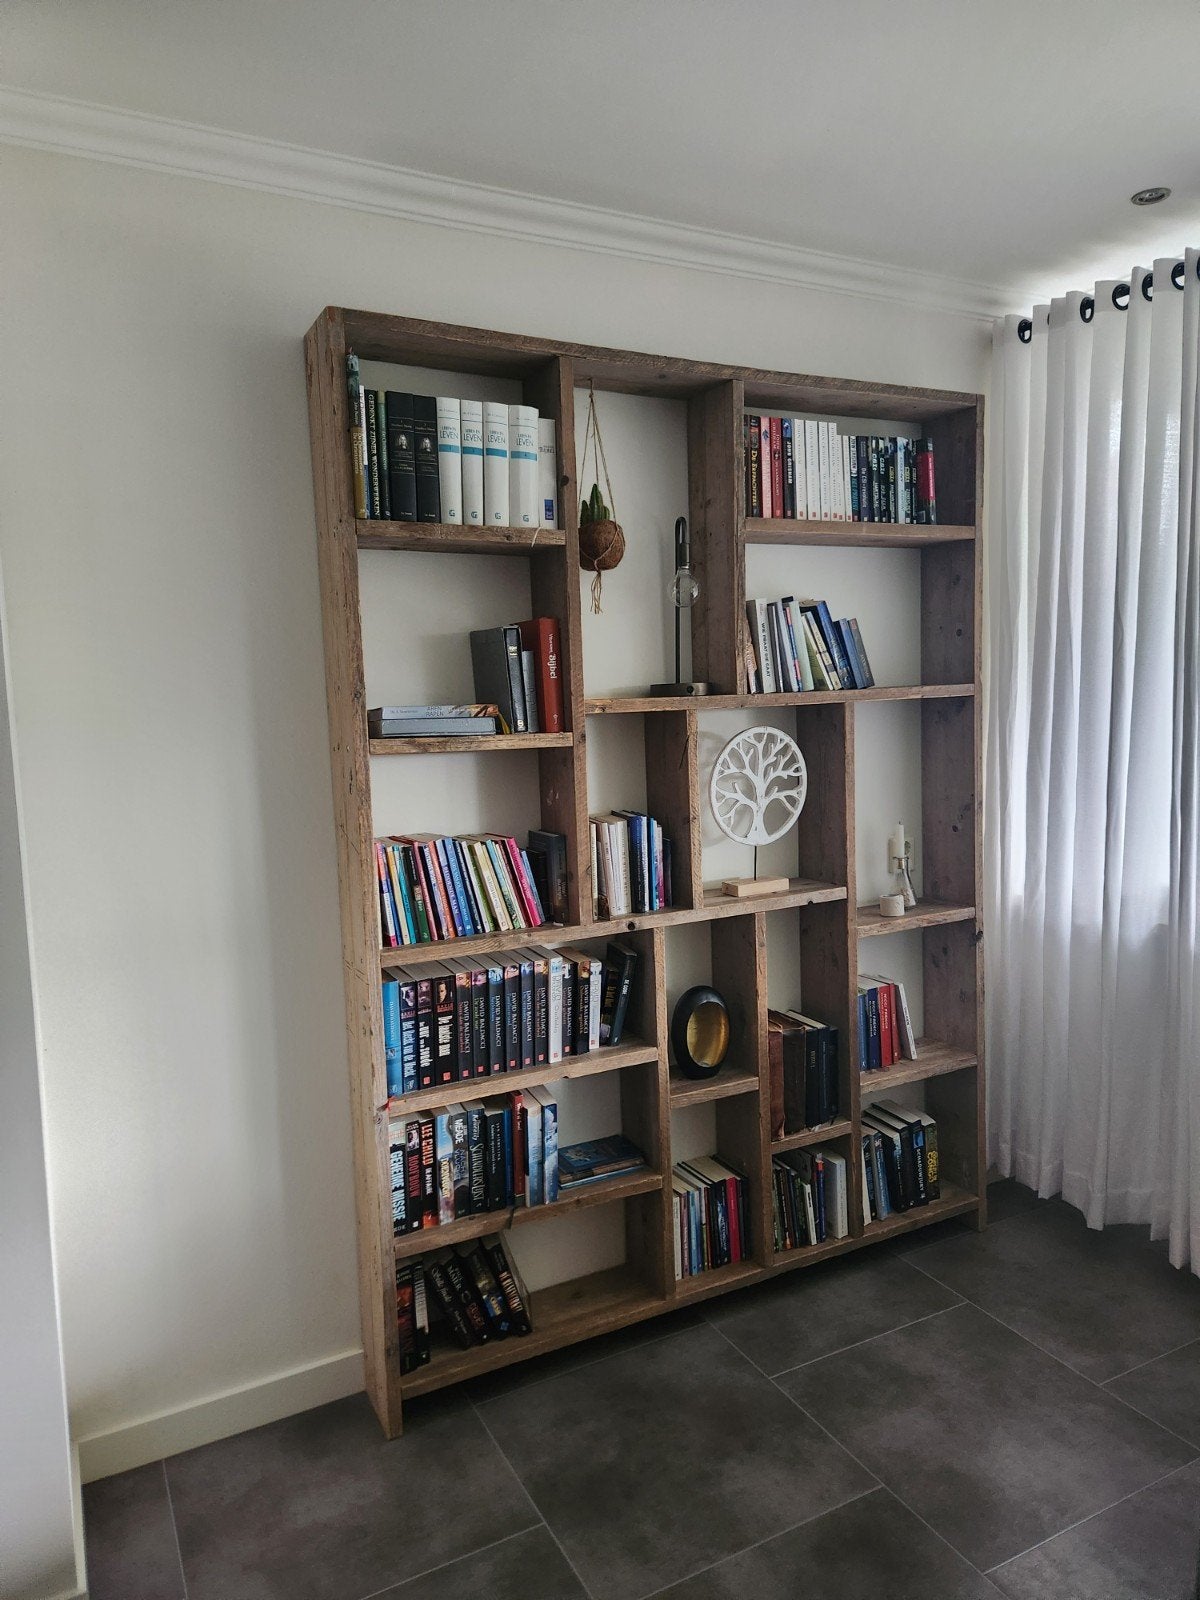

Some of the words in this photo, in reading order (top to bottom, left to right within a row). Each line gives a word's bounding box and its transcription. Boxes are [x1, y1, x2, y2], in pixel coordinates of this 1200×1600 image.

[367, 394, 376, 430] GEDENKT
[369, 431, 377, 455] ZIJNER
[439, 430, 459, 440] LEVEN
[463, 433, 482, 442] LEVEN
[487, 434, 506, 444] LEVEN
[516, 437, 534, 446] LEVEN
[371, 456, 381, 517] WONDERWERKEN
[547, 654, 558, 679] Bijbel
[438, 1015, 453, 1025] De
[439, 1043, 452, 1057] man
[463, 1022, 471, 1054] BALDACCI
[421, 1124, 433, 1140] LEE
[454, 1118, 464, 1145] MEADE
[422, 1138, 434, 1166] CHILD
[389, 1150, 405, 1190] GEHEIME
[407, 1154, 421, 1199] ROOFBOUW
[926, 1151, 935, 1183] CONGO
[425, 1174, 433, 1195] AFFAIRE
[391, 1189, 406, 1222] MISSIE
